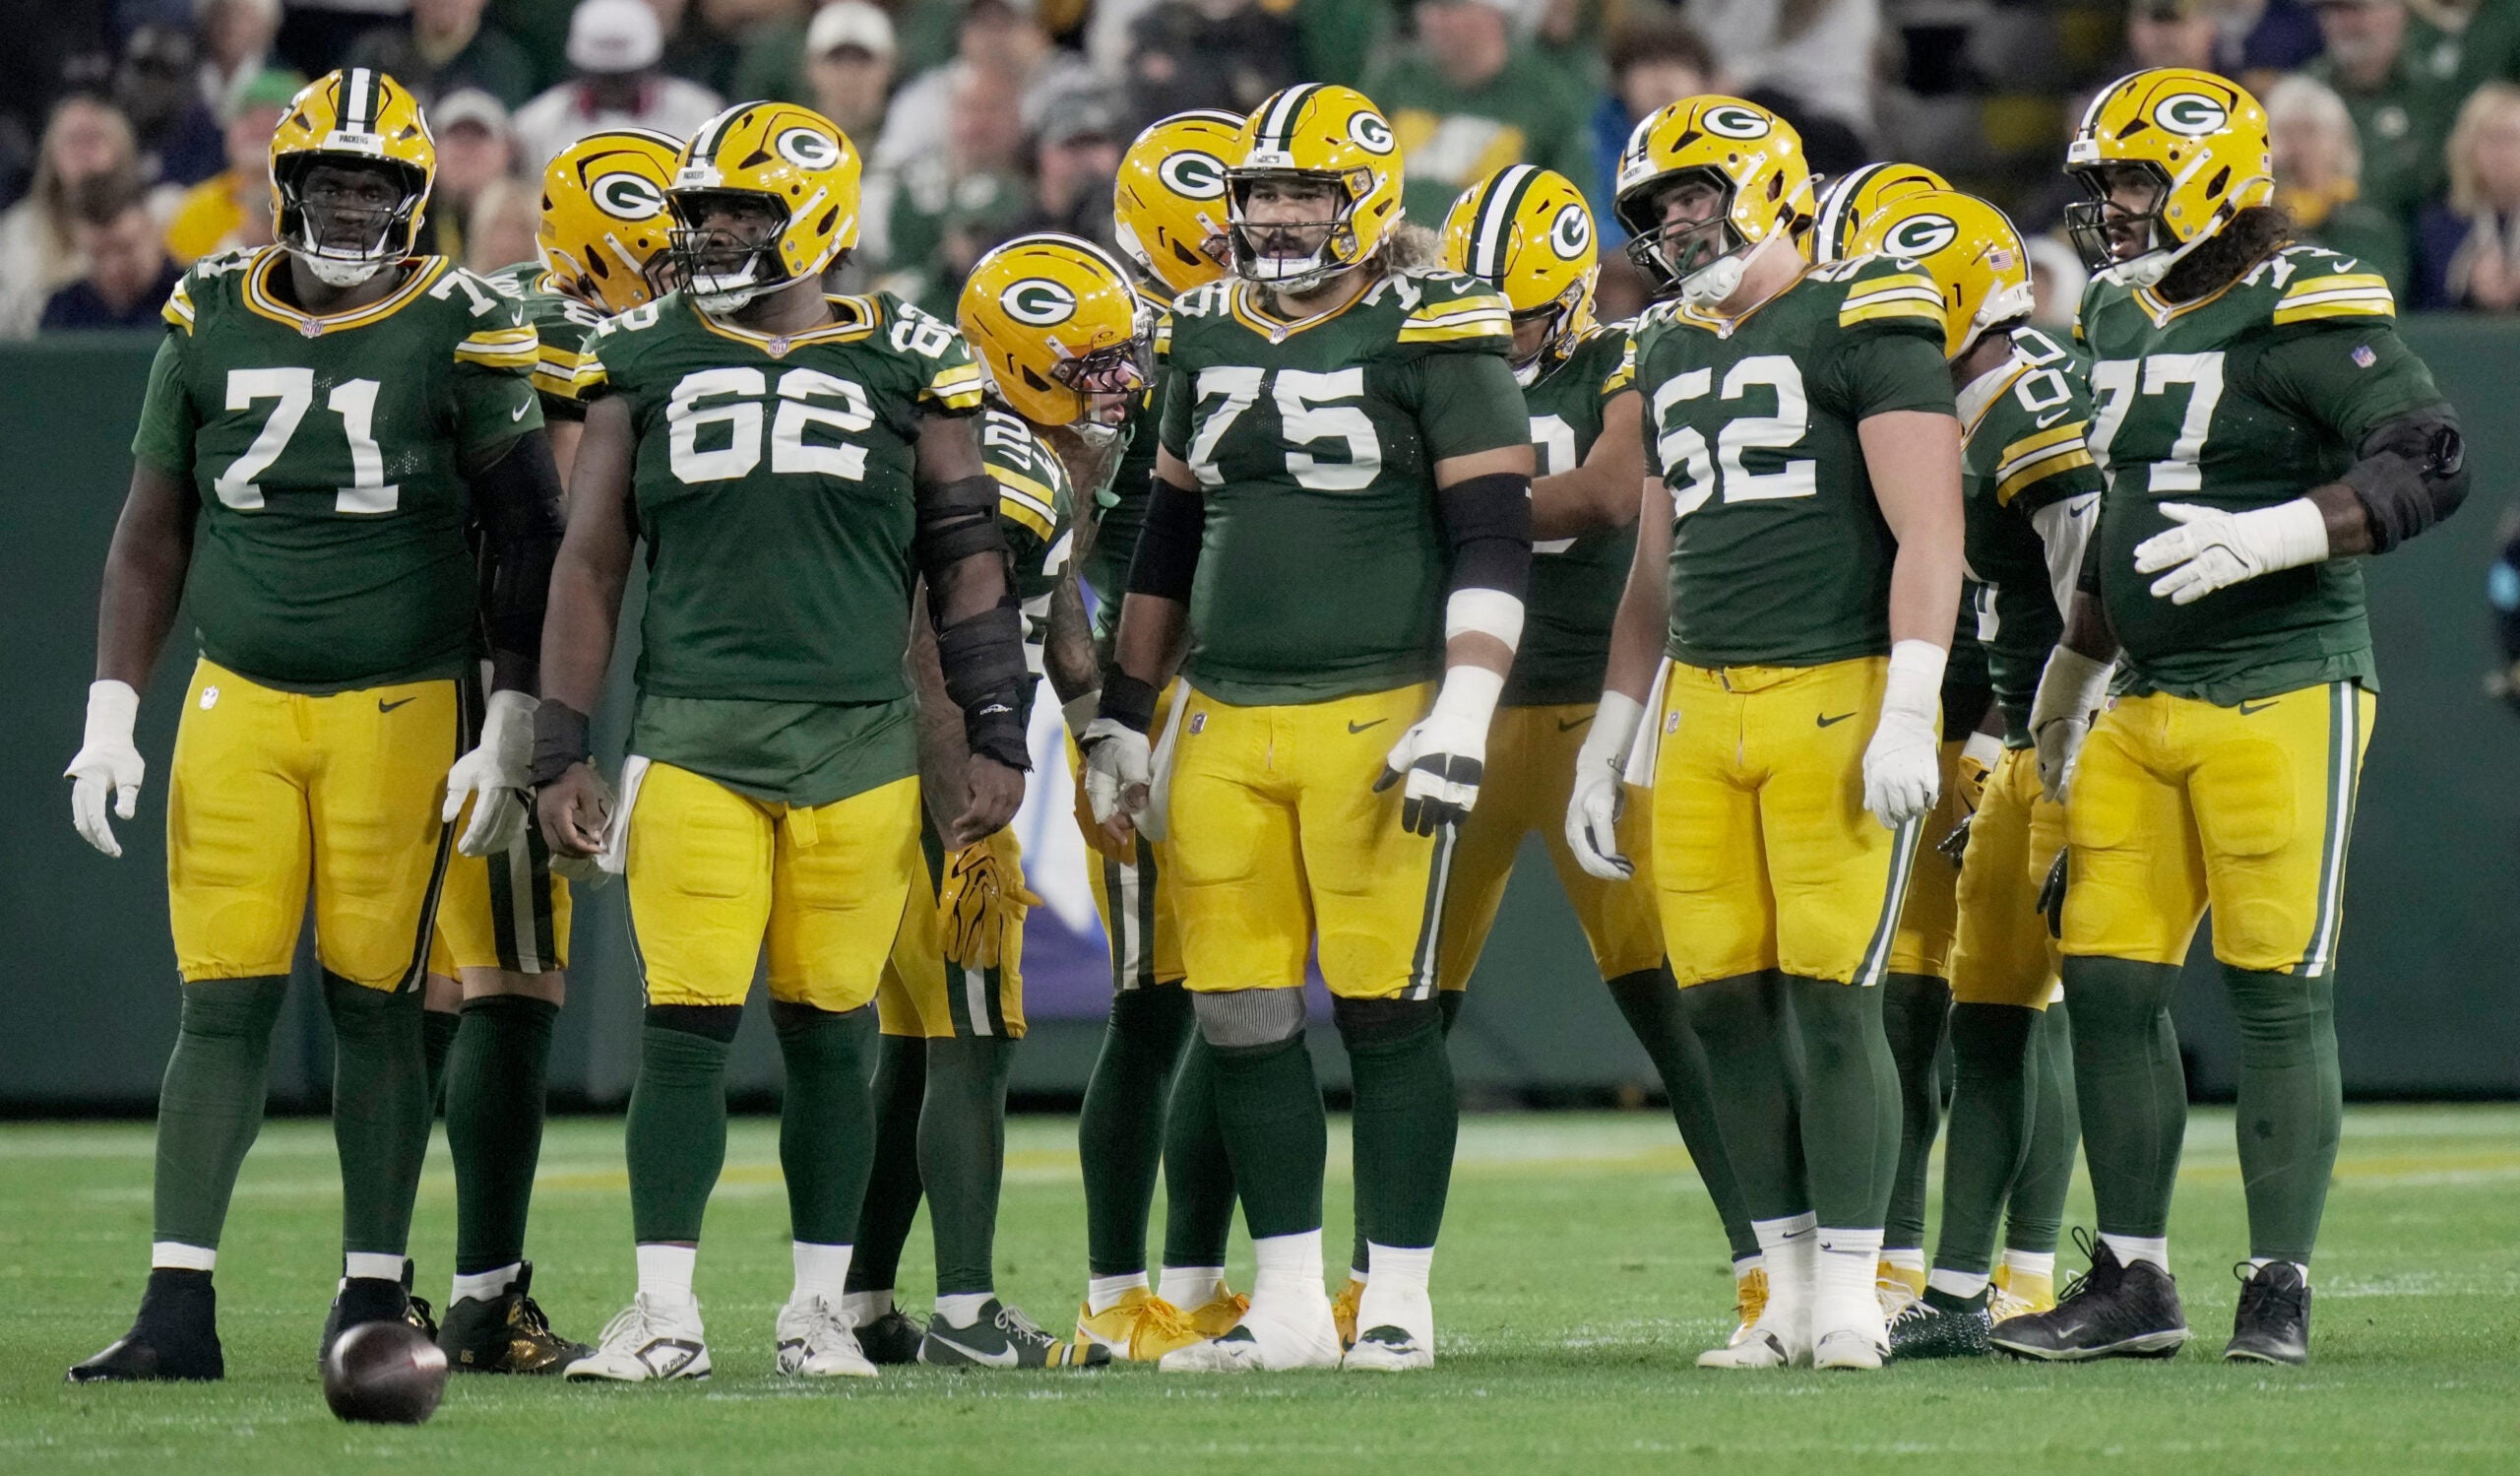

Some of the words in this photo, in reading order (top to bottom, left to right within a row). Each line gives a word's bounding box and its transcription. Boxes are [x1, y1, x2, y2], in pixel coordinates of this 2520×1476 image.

[215, 367, 399, 513] 71
[665, 366, 875, 484] 62
[1188, 366, 1383, 490] 75
[2087, 351, 2226, 492] 77
